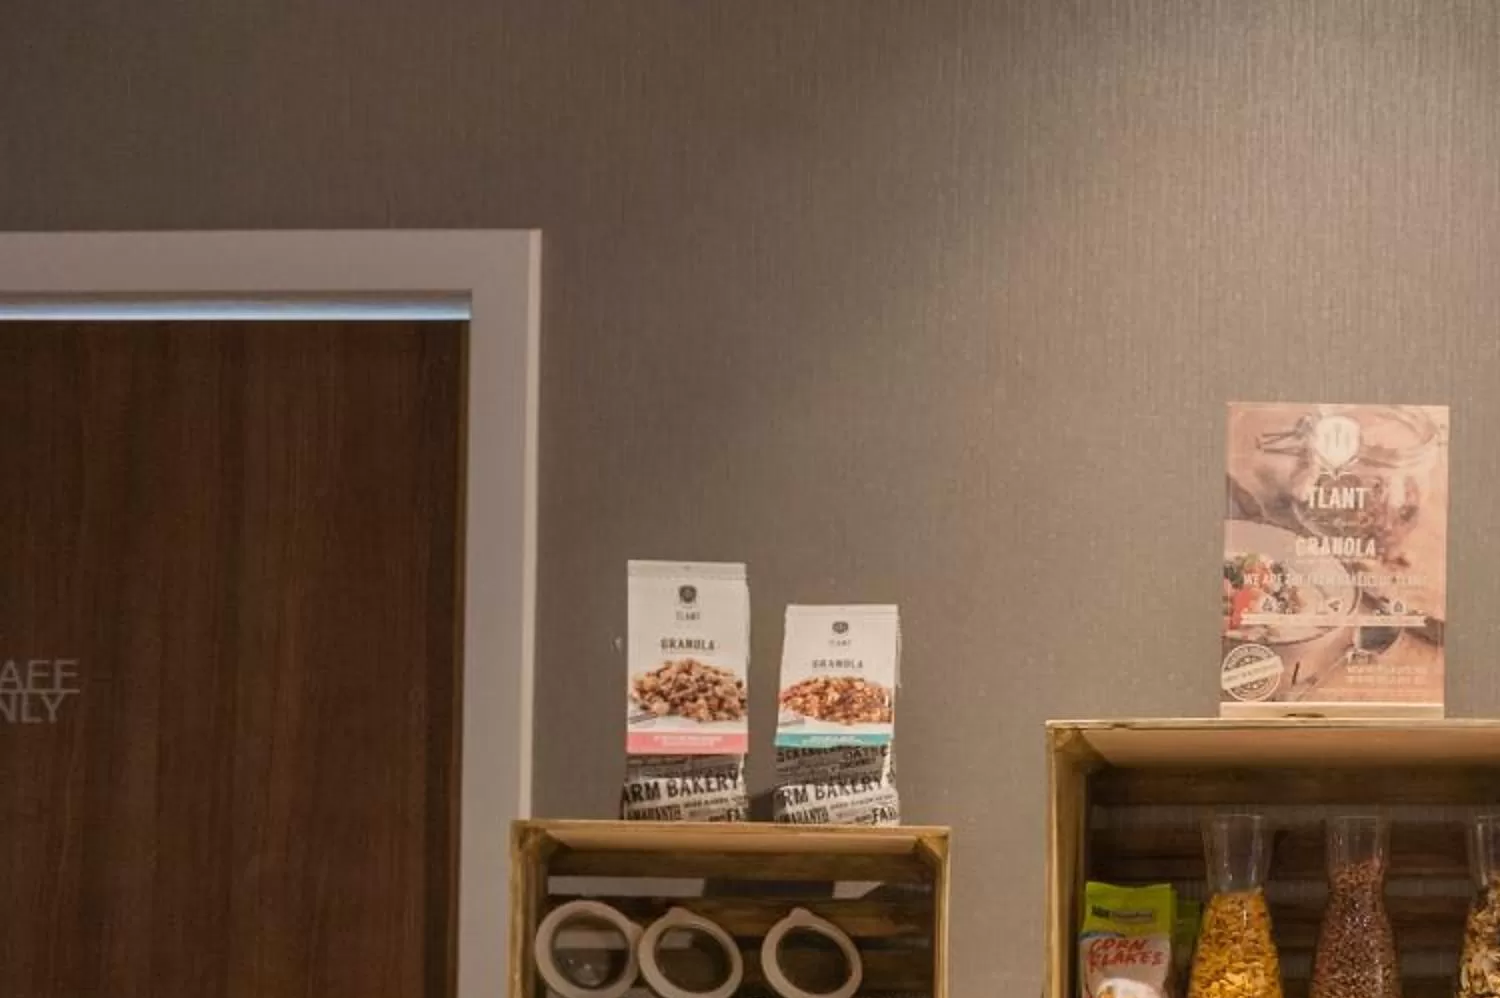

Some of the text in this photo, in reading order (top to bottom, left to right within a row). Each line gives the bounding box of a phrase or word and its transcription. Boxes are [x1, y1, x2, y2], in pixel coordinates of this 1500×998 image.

[667, 768, 739, 798] BAKERY
[815, 774, 884, 800] BAKERY
[1088, 951, 1164, 974] FLAKES
